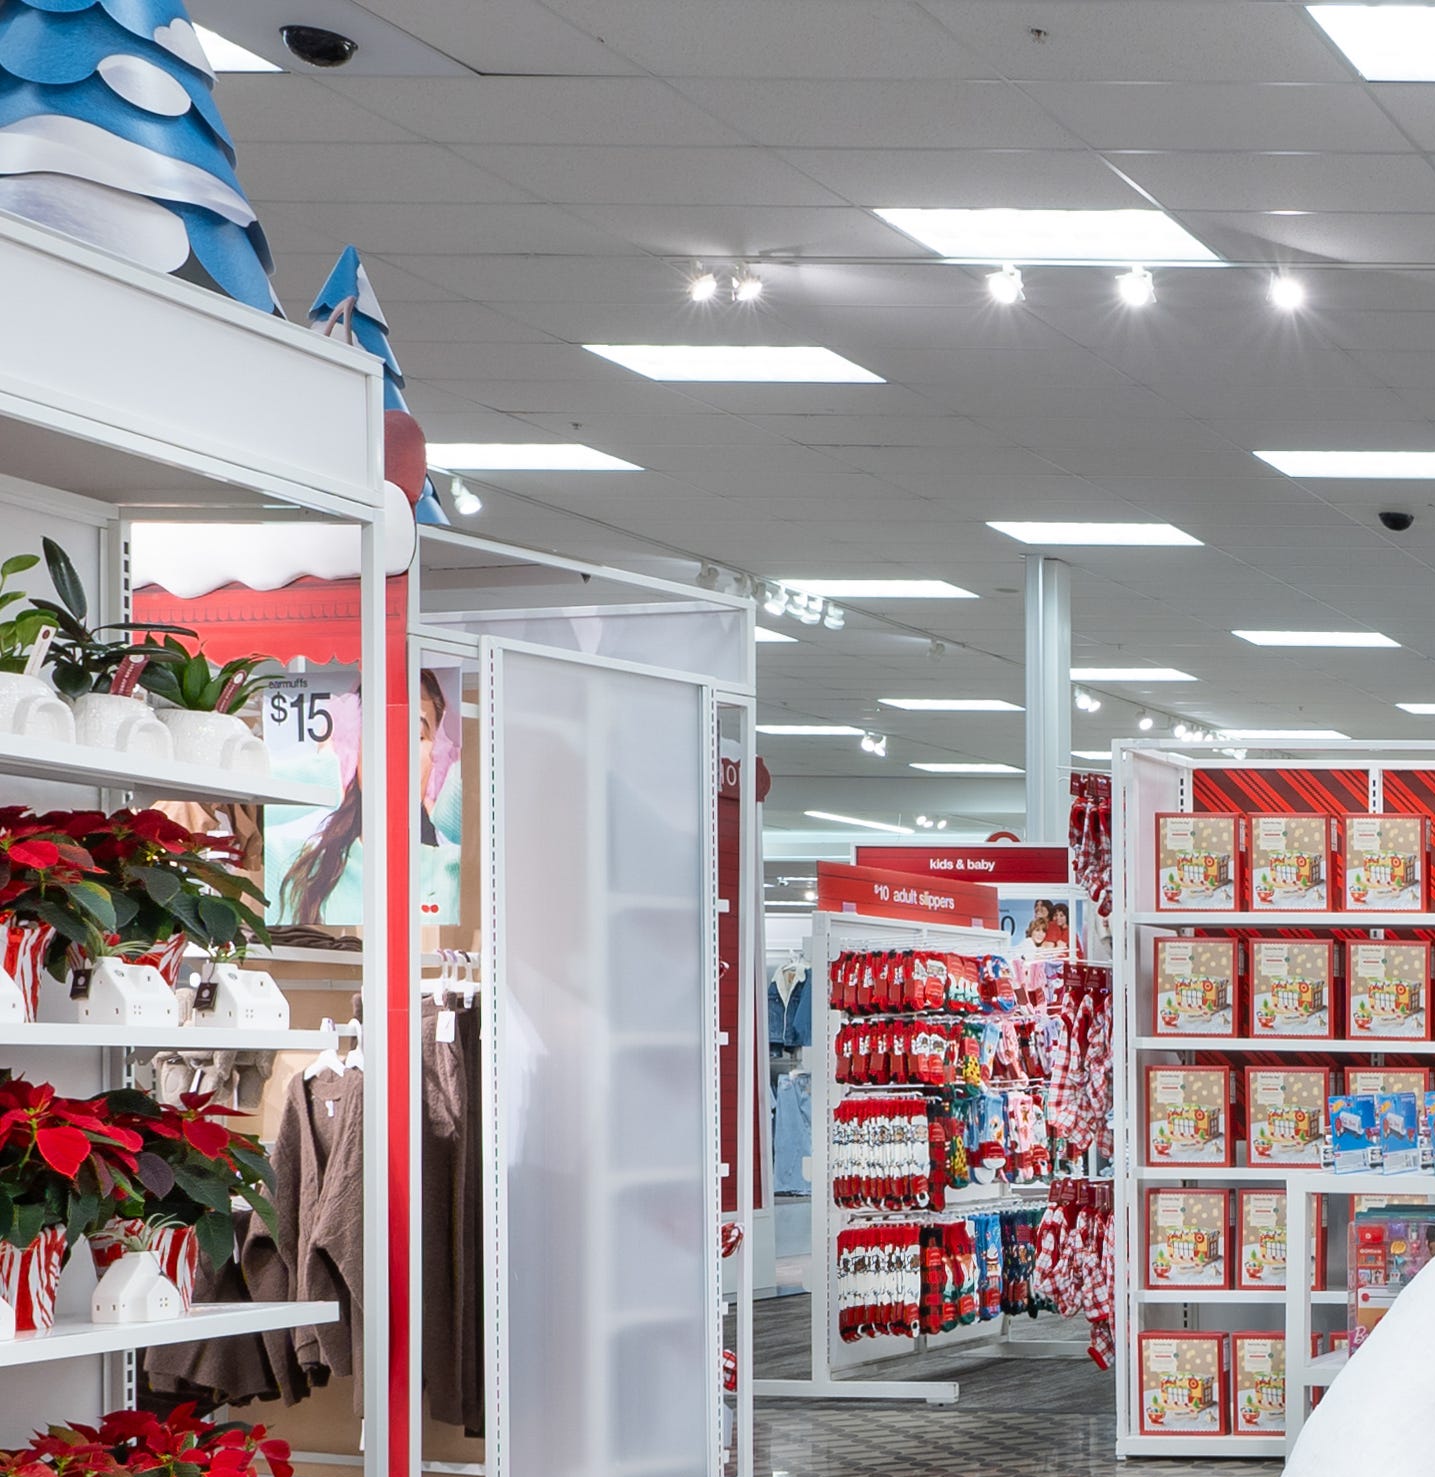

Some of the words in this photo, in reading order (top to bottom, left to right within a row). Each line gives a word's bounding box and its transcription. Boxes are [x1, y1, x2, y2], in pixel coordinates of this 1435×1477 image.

[268, 679, 308, 690] earmuffs
[270, 691, 333, 743] $15
[929, 859, 954, 871] kids
[955, 859, 965, 870] &
[967, 859, 995, 872] baby
[873, 884, 889, 901] $10
[893, 887, 917, 905] adult
[918, 890, 955, 910] slippers
